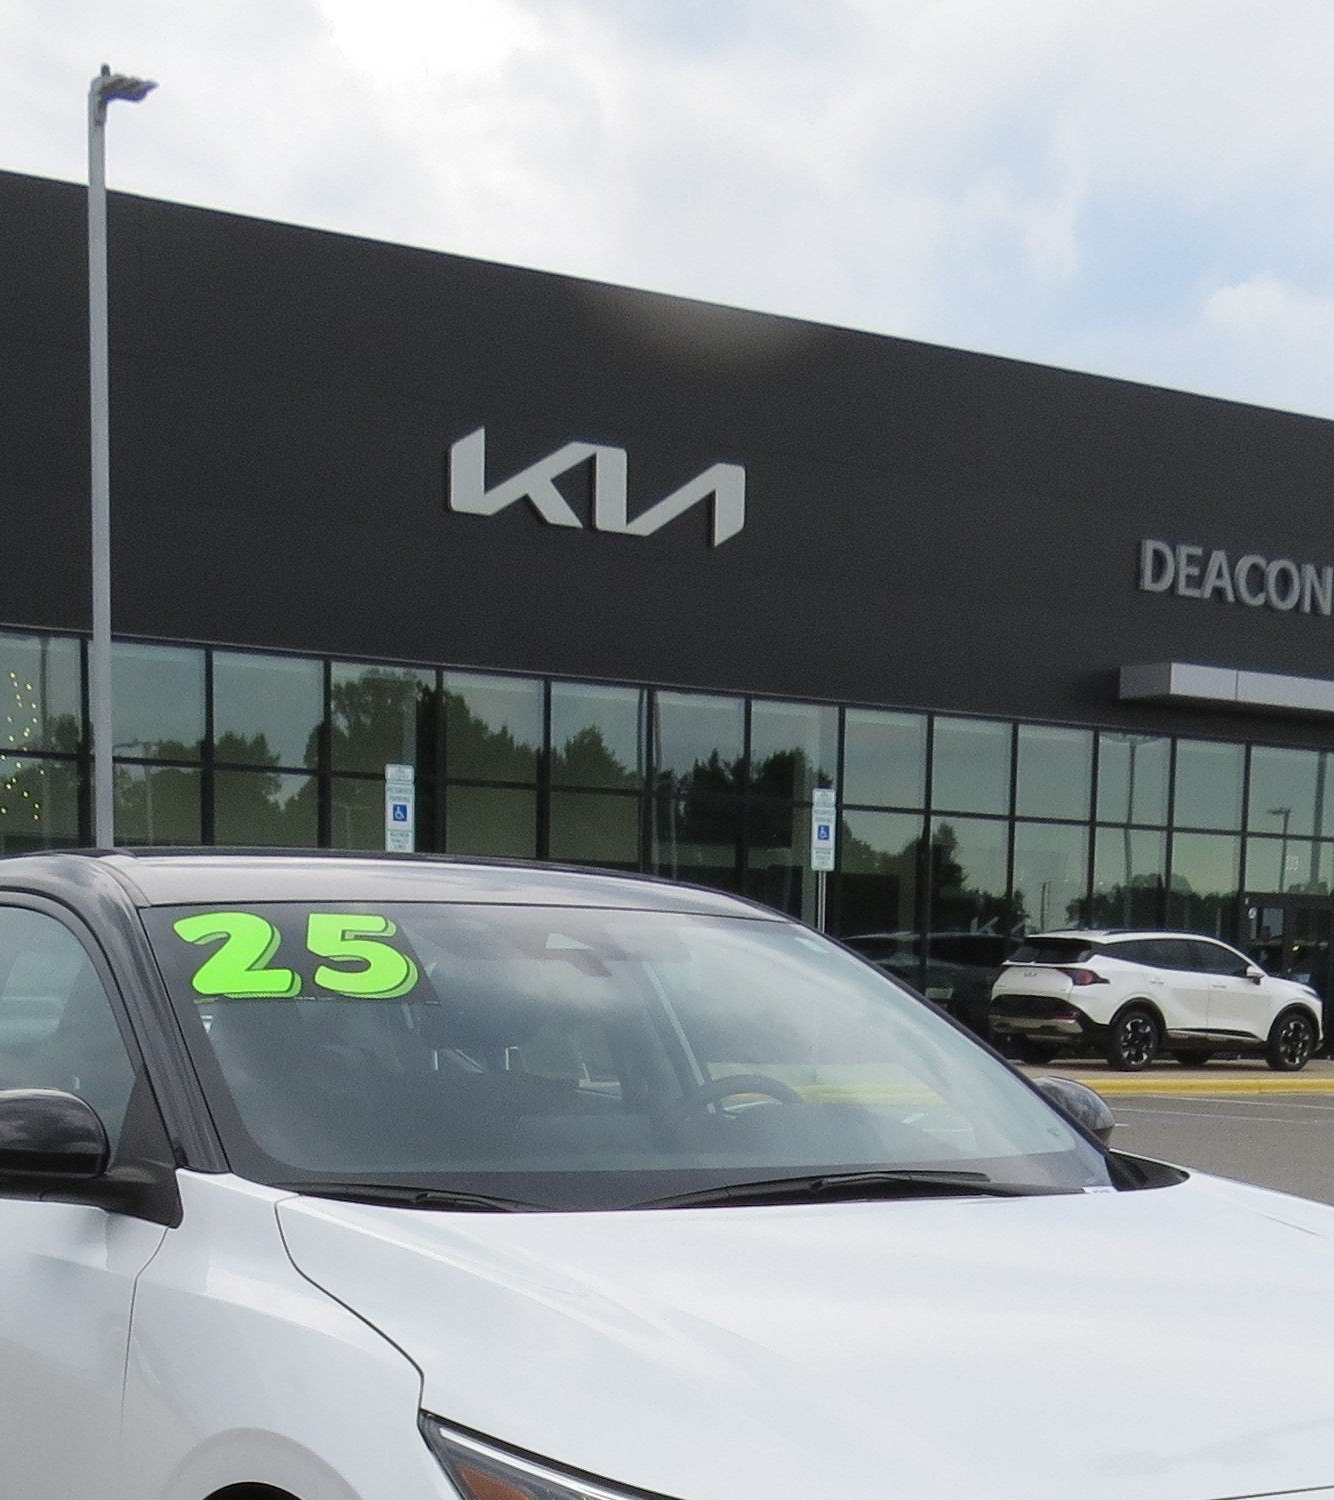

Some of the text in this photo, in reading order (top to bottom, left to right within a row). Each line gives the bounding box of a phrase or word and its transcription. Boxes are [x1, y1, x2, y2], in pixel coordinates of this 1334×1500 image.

[450, 425, 746, 547] KIA
[1140, 539, 1334, 616] DEACON
[173, 911, 418, 999] 25
